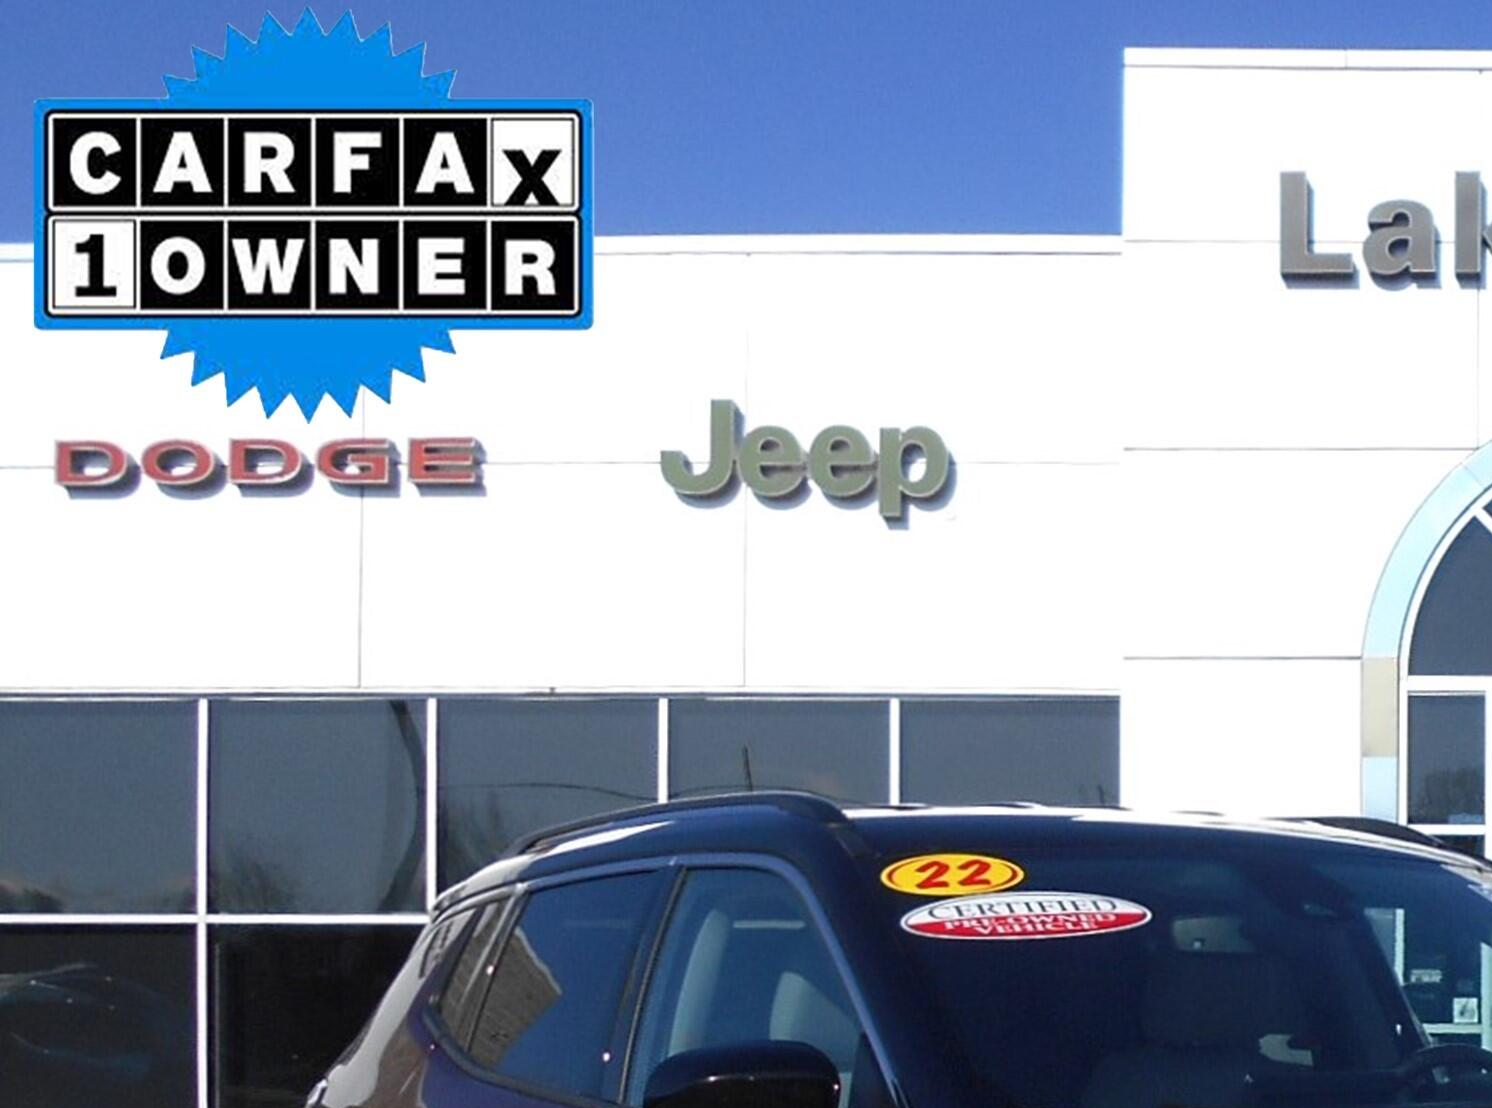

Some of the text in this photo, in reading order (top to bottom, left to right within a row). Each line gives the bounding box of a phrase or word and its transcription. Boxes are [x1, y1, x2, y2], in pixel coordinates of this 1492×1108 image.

[54, 437, 485, 492] DODGE
[660, 399, 952, 521] Jeep
[914, 859, 992, 890] 22
[928, 898, 1117, 920] CERTIFIED
[943, 912, 1117, 931] PRE-OWNED
[973, 917, 1100, 936] VEHICLE
